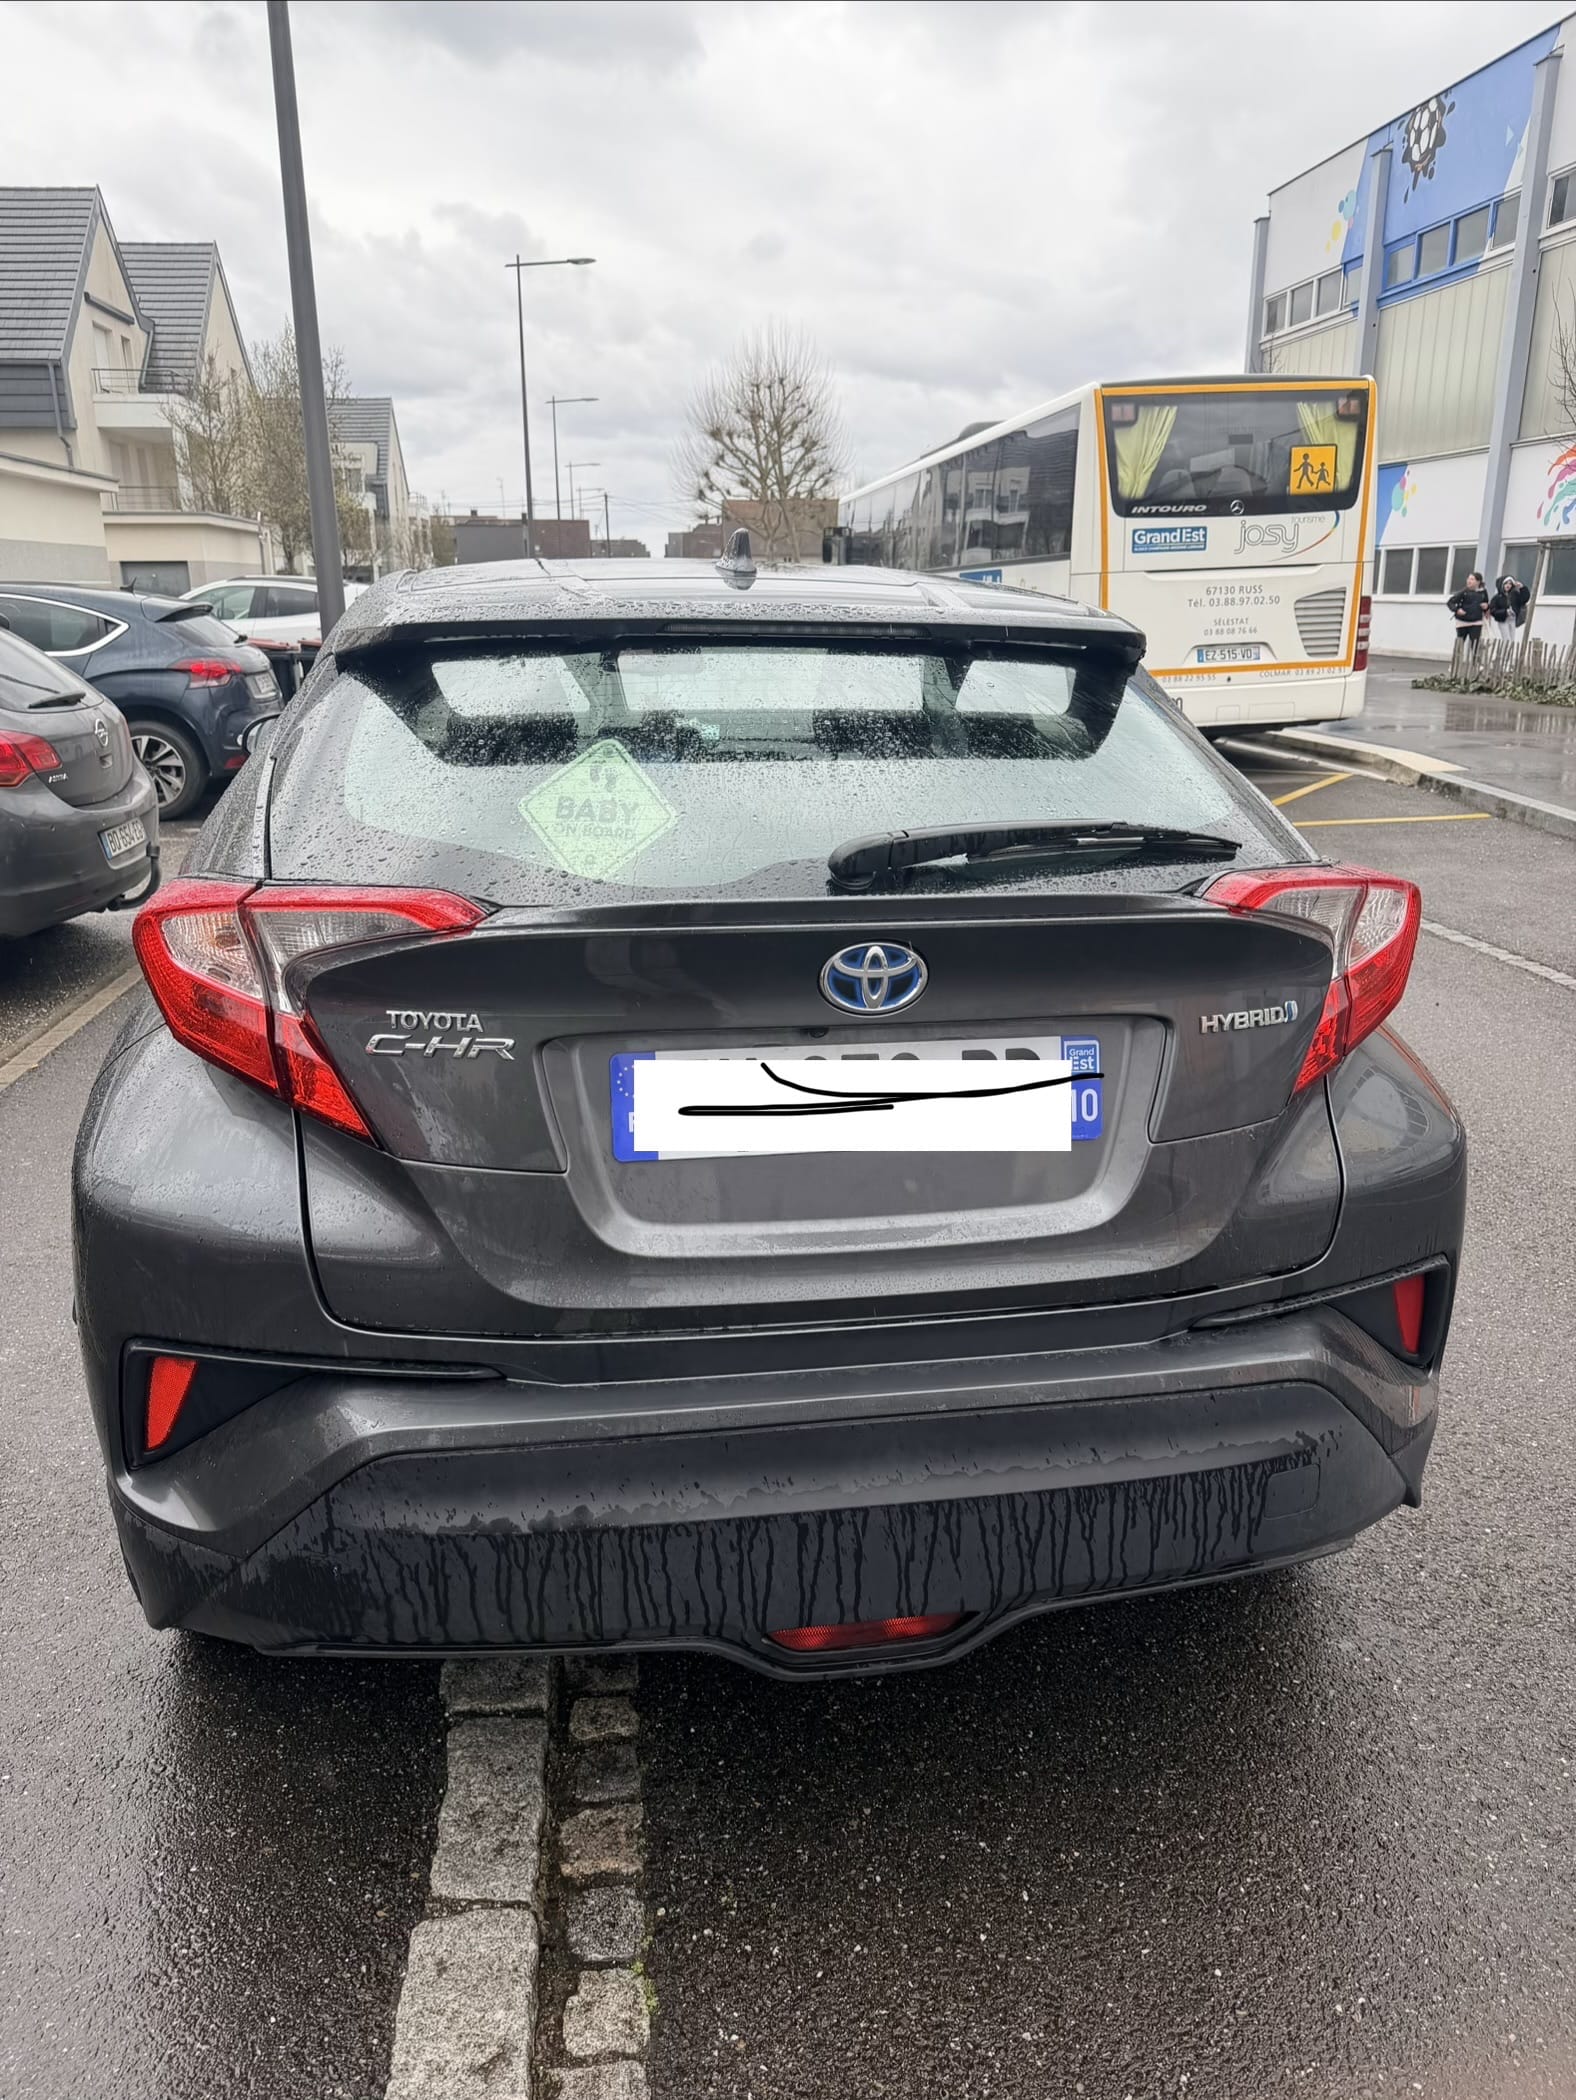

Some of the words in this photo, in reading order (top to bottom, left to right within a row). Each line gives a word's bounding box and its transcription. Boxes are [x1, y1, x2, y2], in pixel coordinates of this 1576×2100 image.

[1131, 504, 1208, 514] INTOURO
[1234, 519, 1300, 555] josy
[1206, 586, 1236, 596] 67130
[1238, 585, 1264, 594] RUSS
[1188, 598, 1206, 608] Tél.
[1208, 595, 1281, 608] 03.88.97.02.50
[1213, 617, 1250, 626] SÉLESTAT
[555, 795, 640, 825] BABY
[553, 821, 578, 836] ON
[581, 824, 636, 840] BOARD
[385, 1010, 484, 1033] TOYOTA
[1200, 1006, 1285, 1034] HYBRID
[366, 1033, 516, 1061] C-HR
[1069, 1047, 1095, 1057] Grand
[1069, 1056, 1095, 1070] Est
